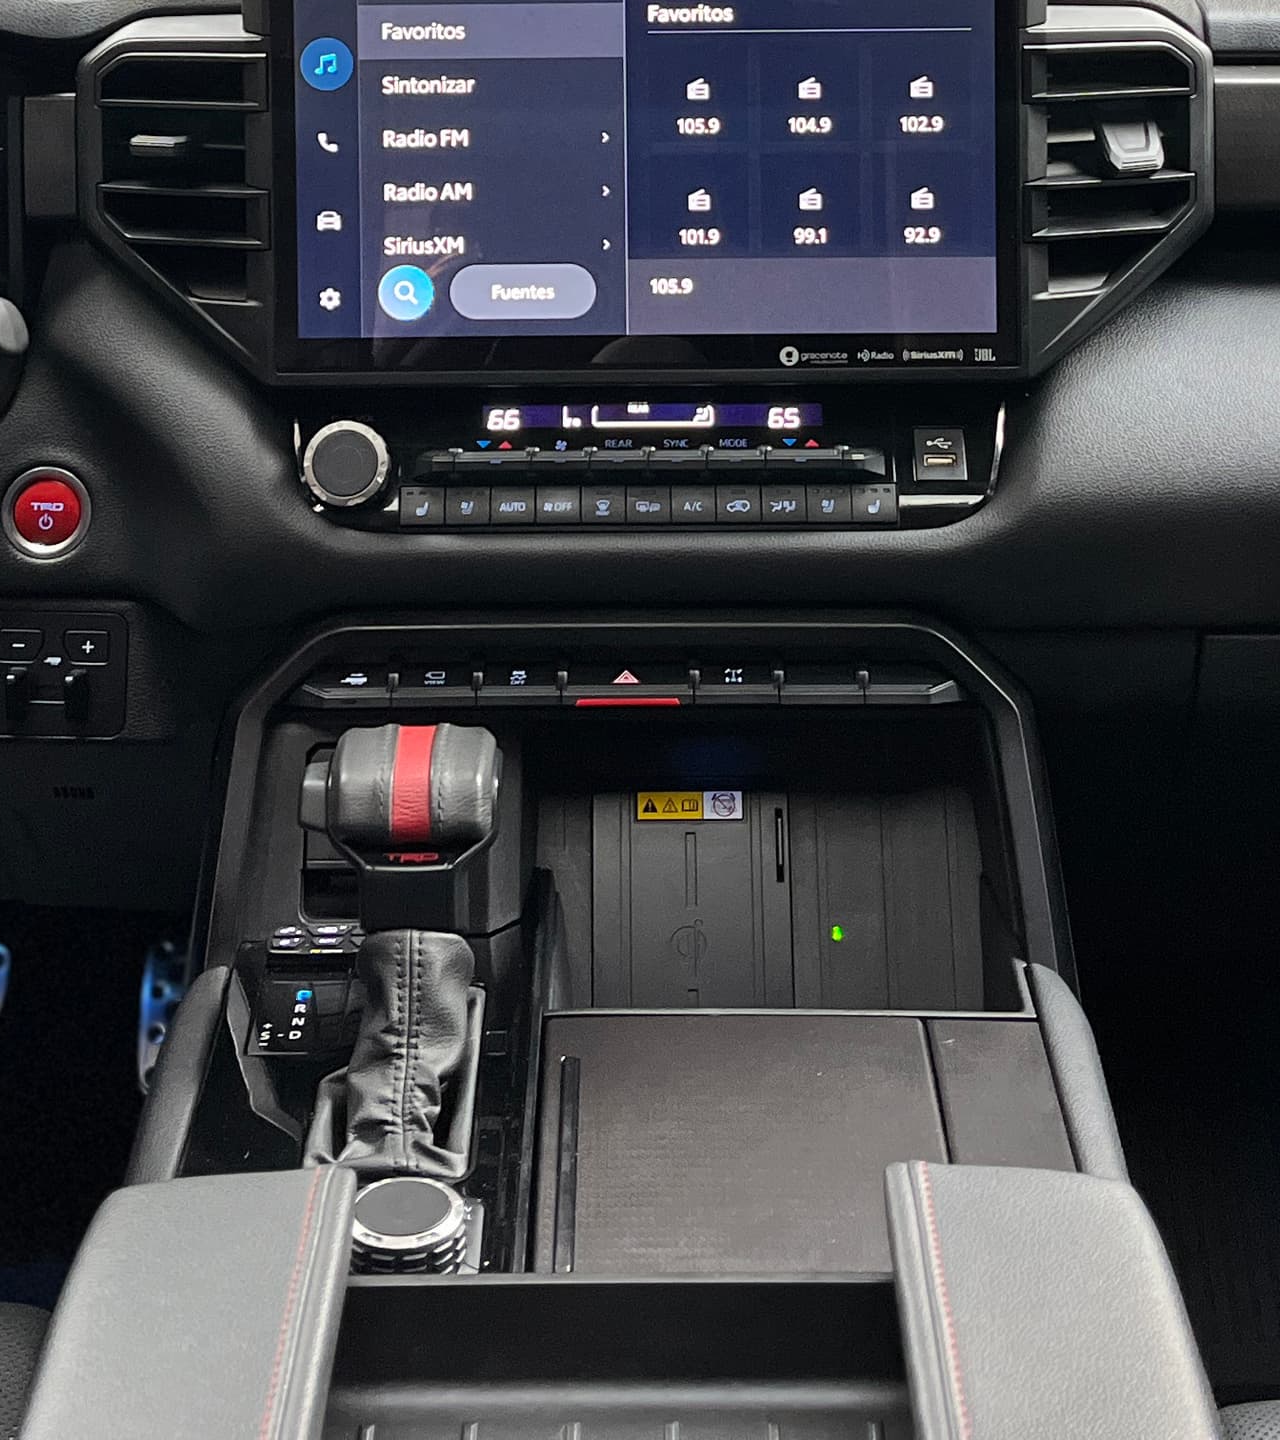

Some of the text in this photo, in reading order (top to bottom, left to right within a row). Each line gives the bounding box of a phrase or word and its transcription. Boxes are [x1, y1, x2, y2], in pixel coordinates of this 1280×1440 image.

[646, 4, 734, 23] Favoritos
[381, 22, 466, 41] Favoritos
[381, 75, 476, 95] Sintonizar
[676, 117, 720, 135] 105.9
[788, 116, 832, 134] 104.9
[899, 115, 944, 133] 102.9
[383, 129, 470, 148] Radio FM
[383, 183, 473, 202] Radio AM
[679, 228, 720, 246] 101.9
[793, 227, 828, 244] 99.1
[904, 226, 942, 244] 92.9
[383, 236, 465, 255] SiriusXM
[491, 284, 555, 300] Fuentes
[650, 277, 693, 295] 105.9
[801, 350, 848, 361] gracenote
[870, 351, 894, 360] Radio
[975, 348, 996, 362] JBL
[487, 409, 521, 431] 66
[604, 439, 633, 449] REAR
[663, 438, 689, 449] SYNC
[719, 438, 748, 449] MODE
[30, 502, 65, 512] TRD
[499, 501, 526, 512] AUTO
[554, 501, 573, 512] OFF
[683, 501, 703, 512] A/C
[383, 852, 439, 863] TRD
[294, 1003, 307, 1014] R
[291, 1016, 306, 1027] N
[260, 1030, 302, 1041] S D
